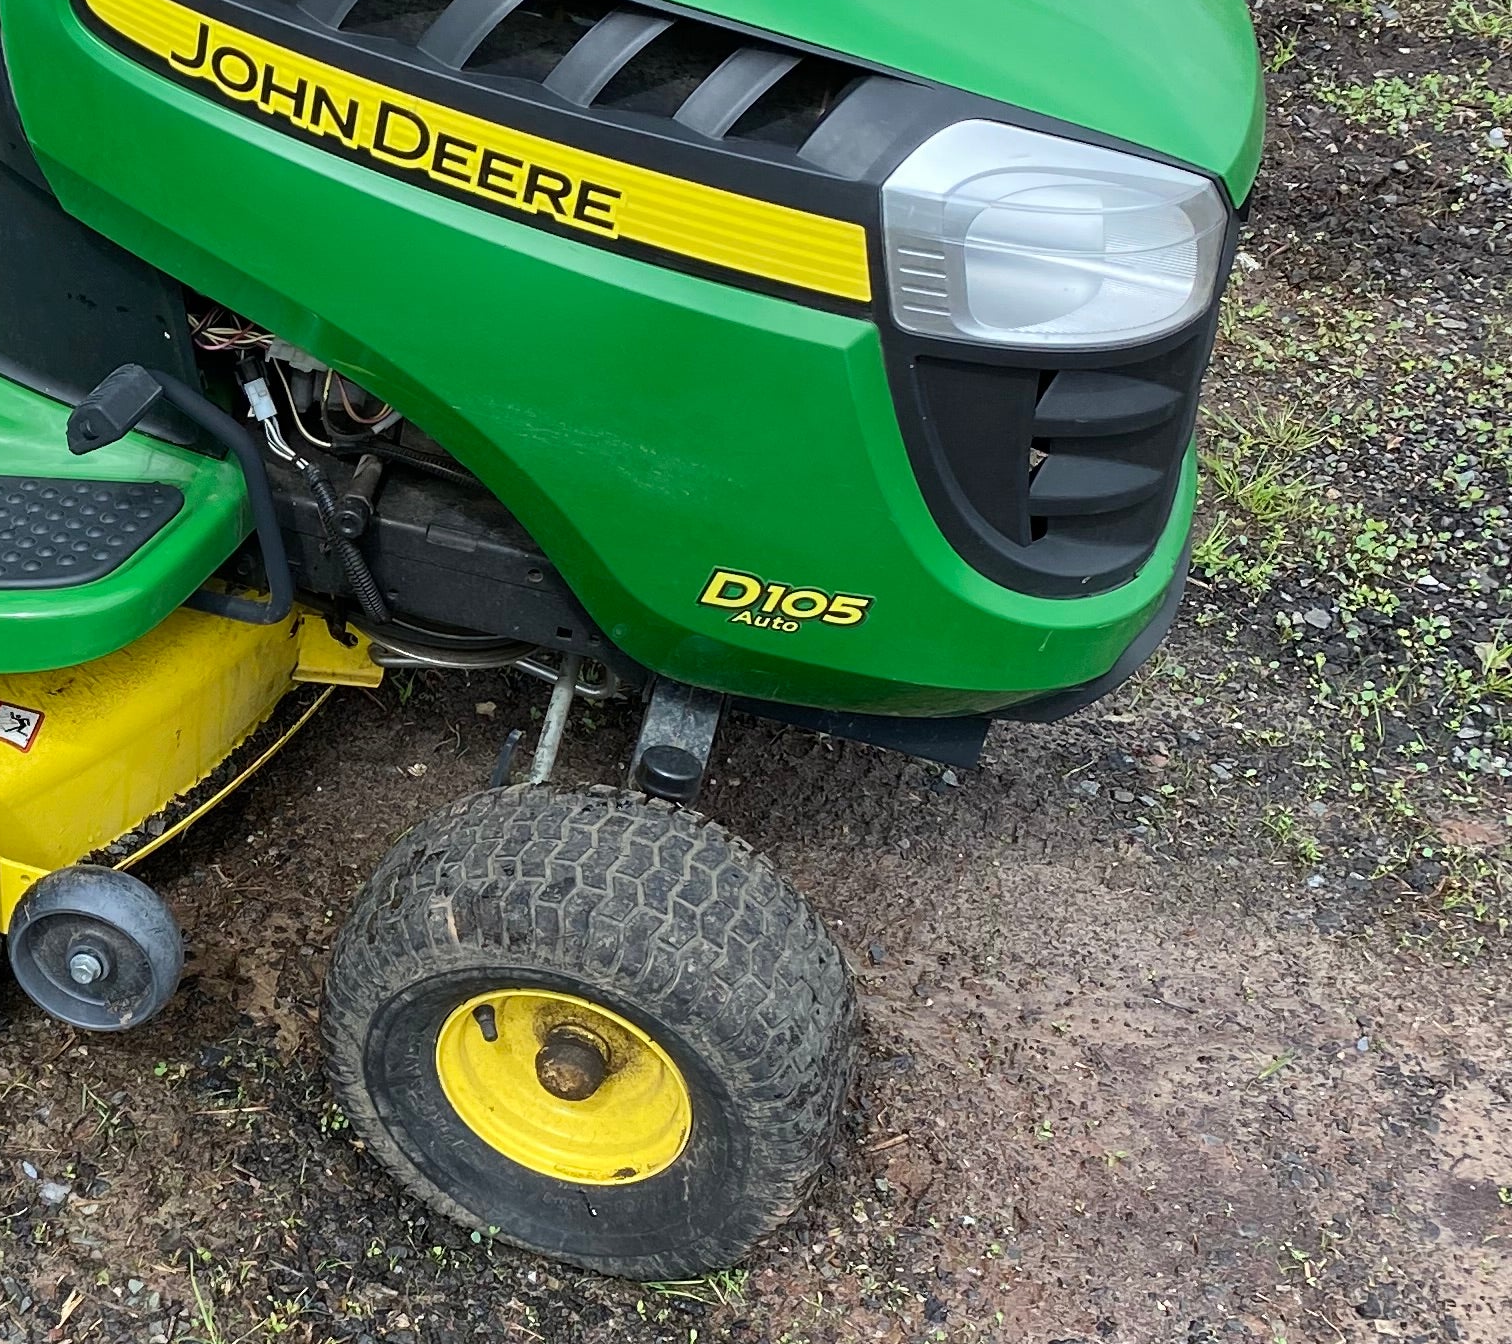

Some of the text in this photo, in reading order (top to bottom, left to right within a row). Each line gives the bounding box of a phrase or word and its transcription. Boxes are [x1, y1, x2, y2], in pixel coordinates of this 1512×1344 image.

[170, 22, 622, 232] JOHN DEERE
[699, 568, 873, 626] D105
[729, 610, 800, 633] Auto
